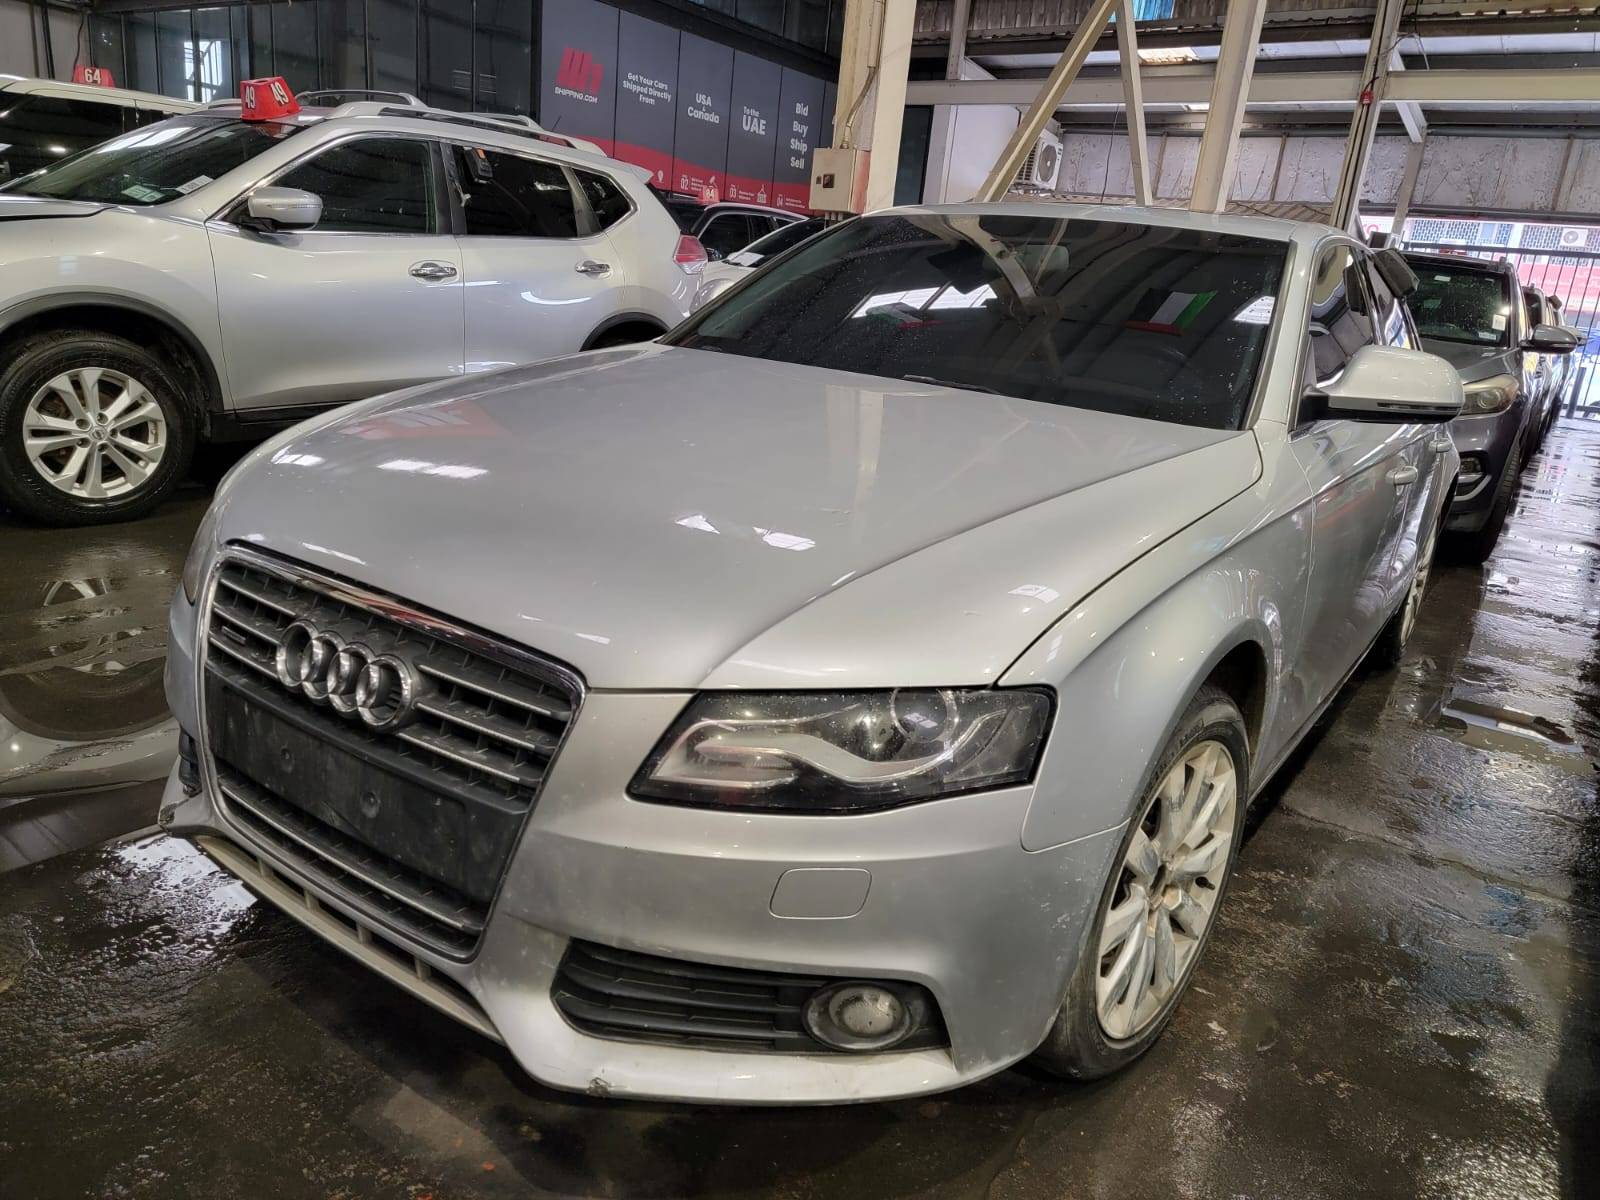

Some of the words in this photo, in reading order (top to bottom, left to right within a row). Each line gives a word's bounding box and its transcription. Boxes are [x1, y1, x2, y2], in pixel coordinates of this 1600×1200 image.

[84, 68, 101, 84] 64
[627, 72, 639, 81] Get
[639, 75, 653, 86] Your
[653, 80, 668, 90] Cars
[245, 85, 256, 109] 49
[270, 81, 289, 105] 49
[622, 80, 648, 94] Shipped
[648, 88, 672, 103] Directly
[639, 94, 655, 105] From
[695, 92, 712, 107] USA
[687, 106, 720, 123] Canada
[743, 106, 750, 115] To
[750, 107, 760, 117] the
[795, 102, 808, 116] Bid
[742, 115, 767, 135] UAE
[792, 121, 808, 138] Buy
[790, 138, 808, 155] Ship
[790, 157, 805, 169] Sell
[680, 178, 689, 190] 02
[729, 187, 737, 199] 03
